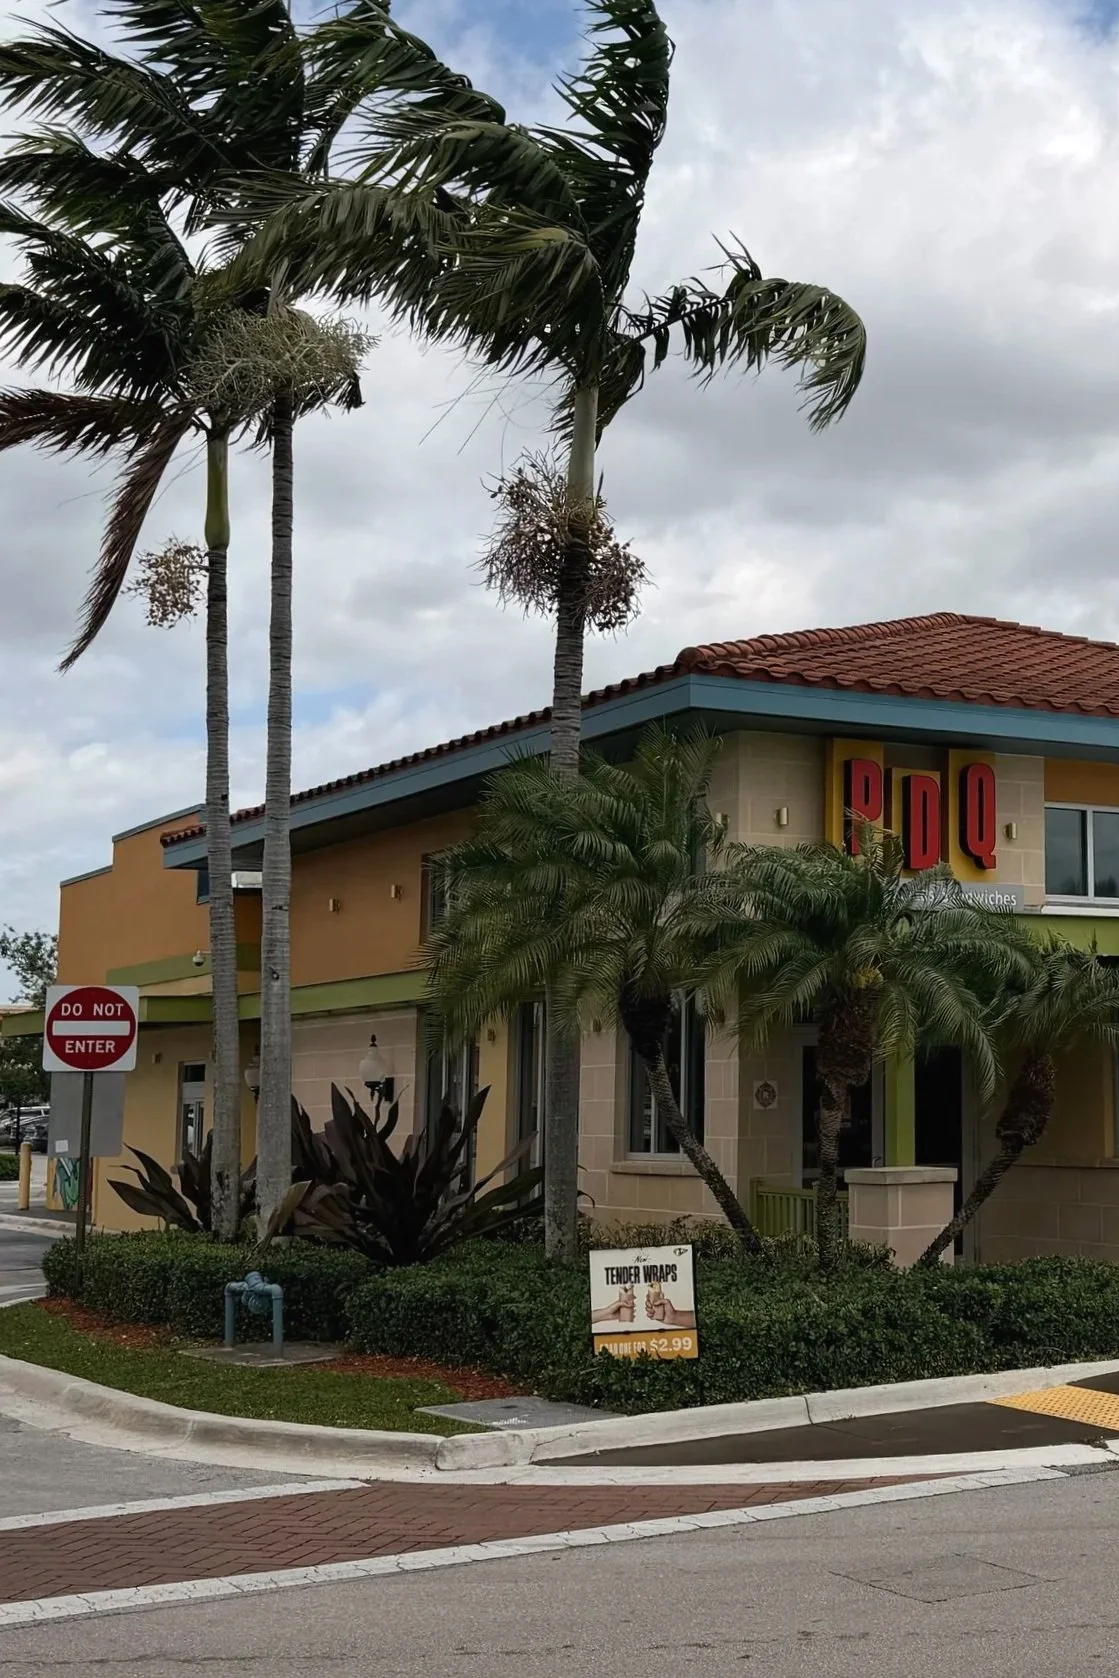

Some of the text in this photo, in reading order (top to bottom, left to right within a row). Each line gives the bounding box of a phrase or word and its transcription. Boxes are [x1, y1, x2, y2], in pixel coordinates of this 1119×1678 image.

[844, 757, 997, 870] PDQ
[61, 1003, 124, 1017] DO NOT
[65, 1040, 116, 1054] ENTER
[604, 1264, 678, 1285] TENDER WRAPS
[649, 1336, 692, 1351] $2.99
